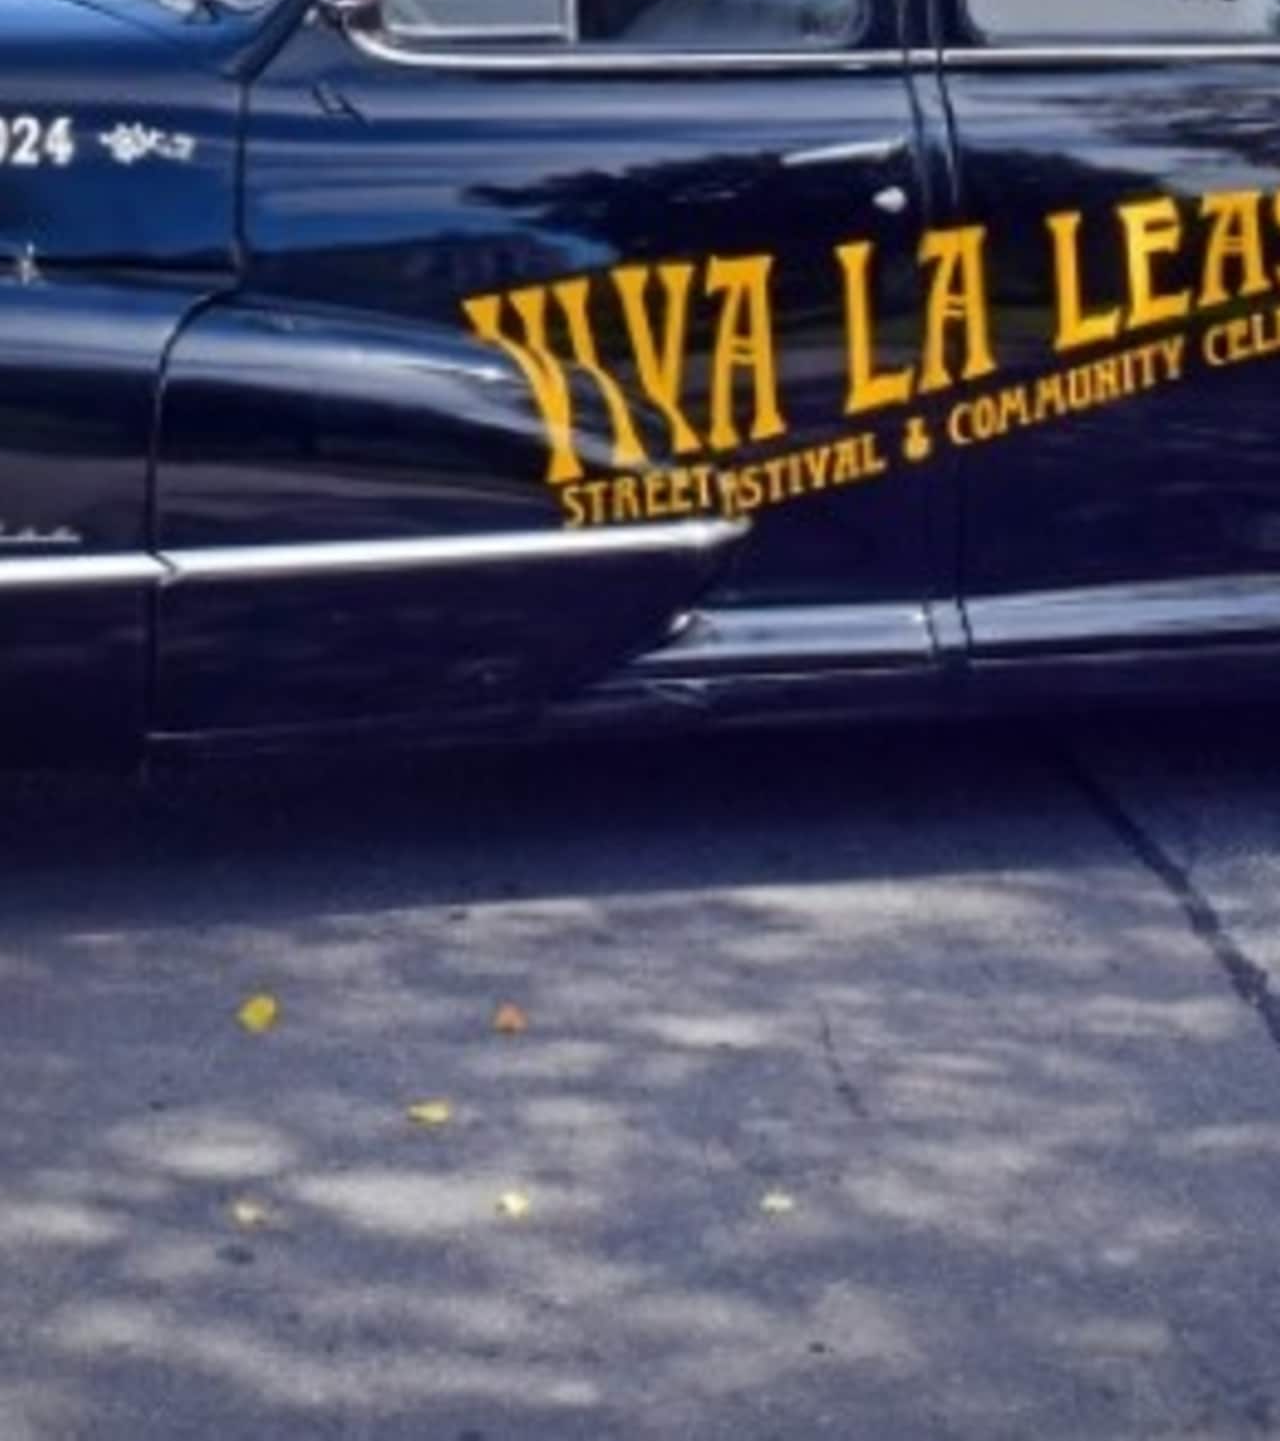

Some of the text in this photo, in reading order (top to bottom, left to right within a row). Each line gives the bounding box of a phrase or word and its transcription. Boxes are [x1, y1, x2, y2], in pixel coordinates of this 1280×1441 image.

[462, 255, 787, 485] VIVA
[834, 224, 997, 415] LA
[561, 466, 713, 528] STREET
[904, 416, 932, 460] &
[948, 336, 1184, 447] COMMUNITY
